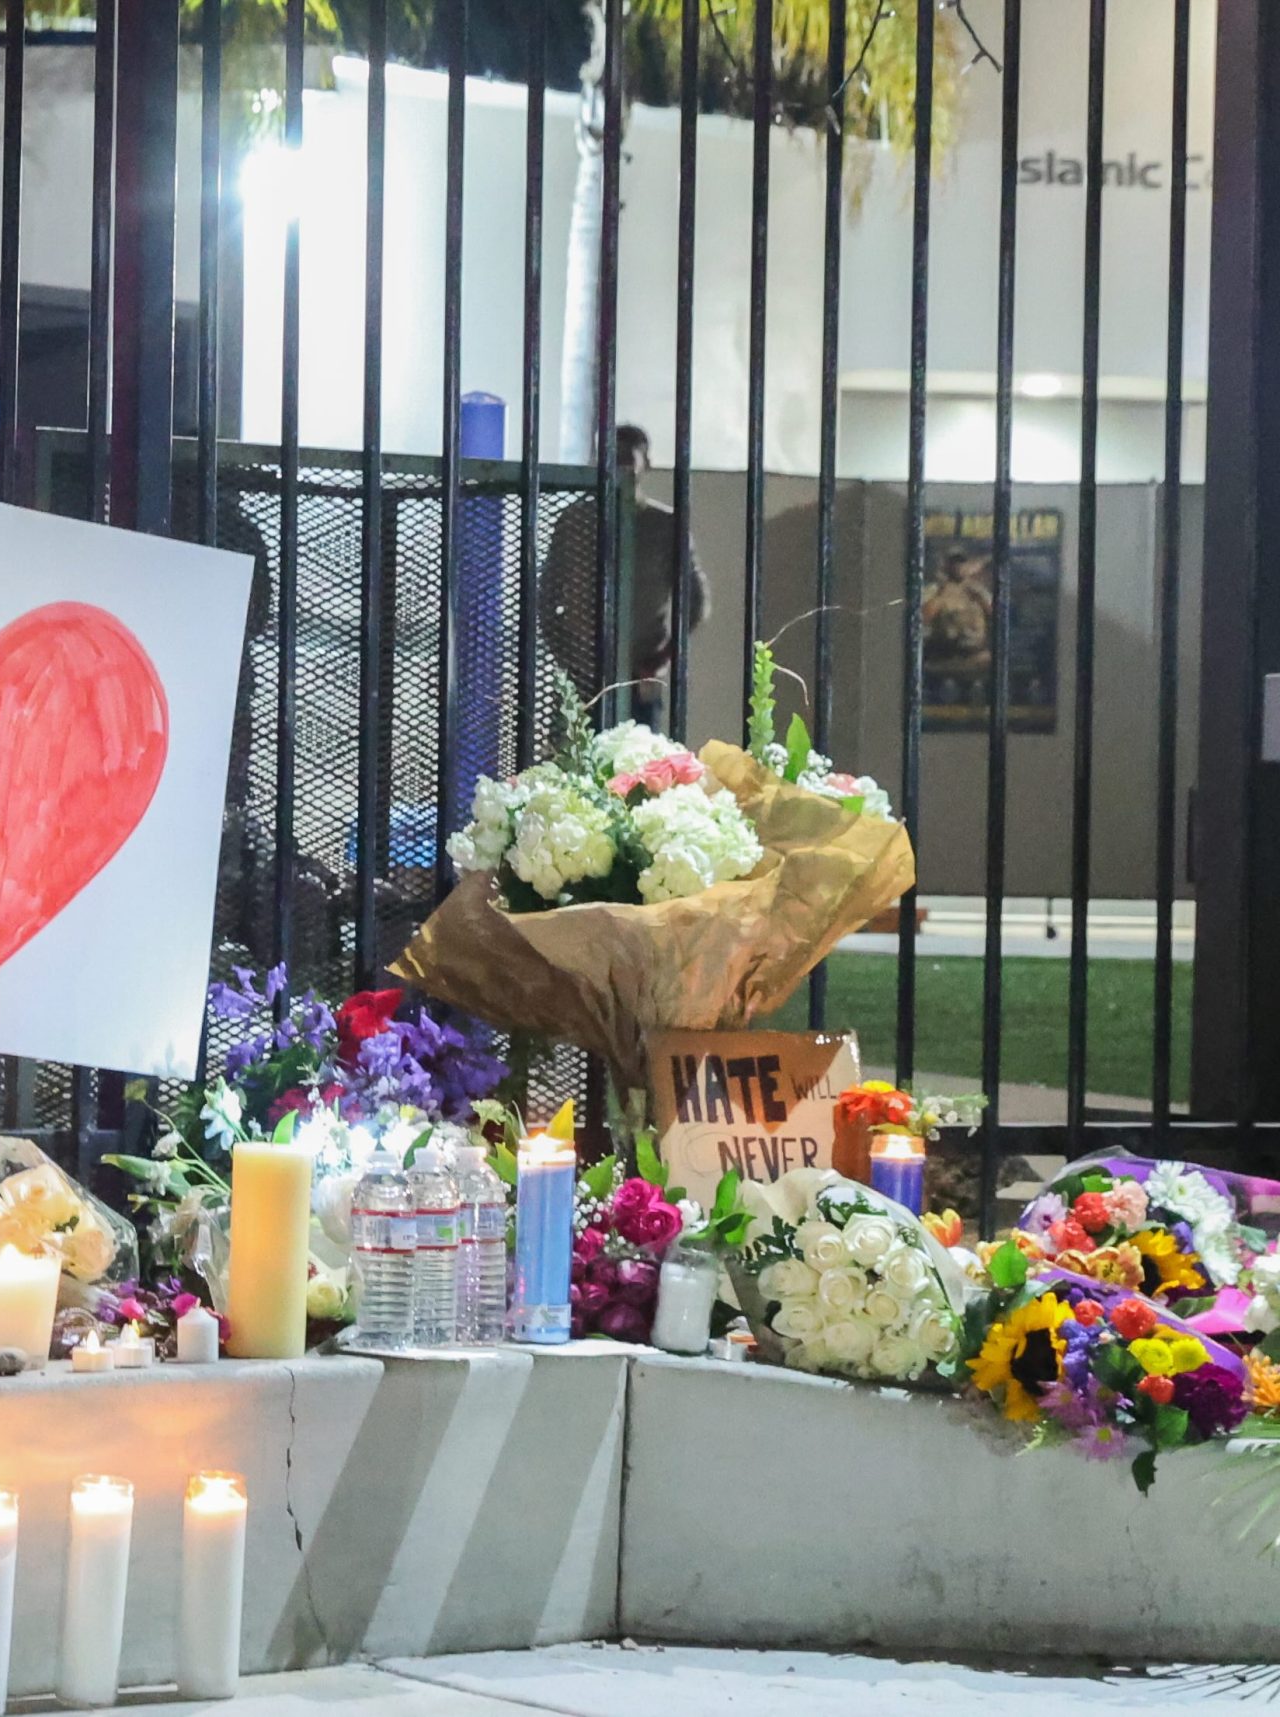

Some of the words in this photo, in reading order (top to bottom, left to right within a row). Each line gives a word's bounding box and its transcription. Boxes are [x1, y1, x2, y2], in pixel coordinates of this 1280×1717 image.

[1017, 149, 1162, 189] slamic
[671, 1053, 787, 1124] HATE
[717, 1135, 818, 1183] NEVER
